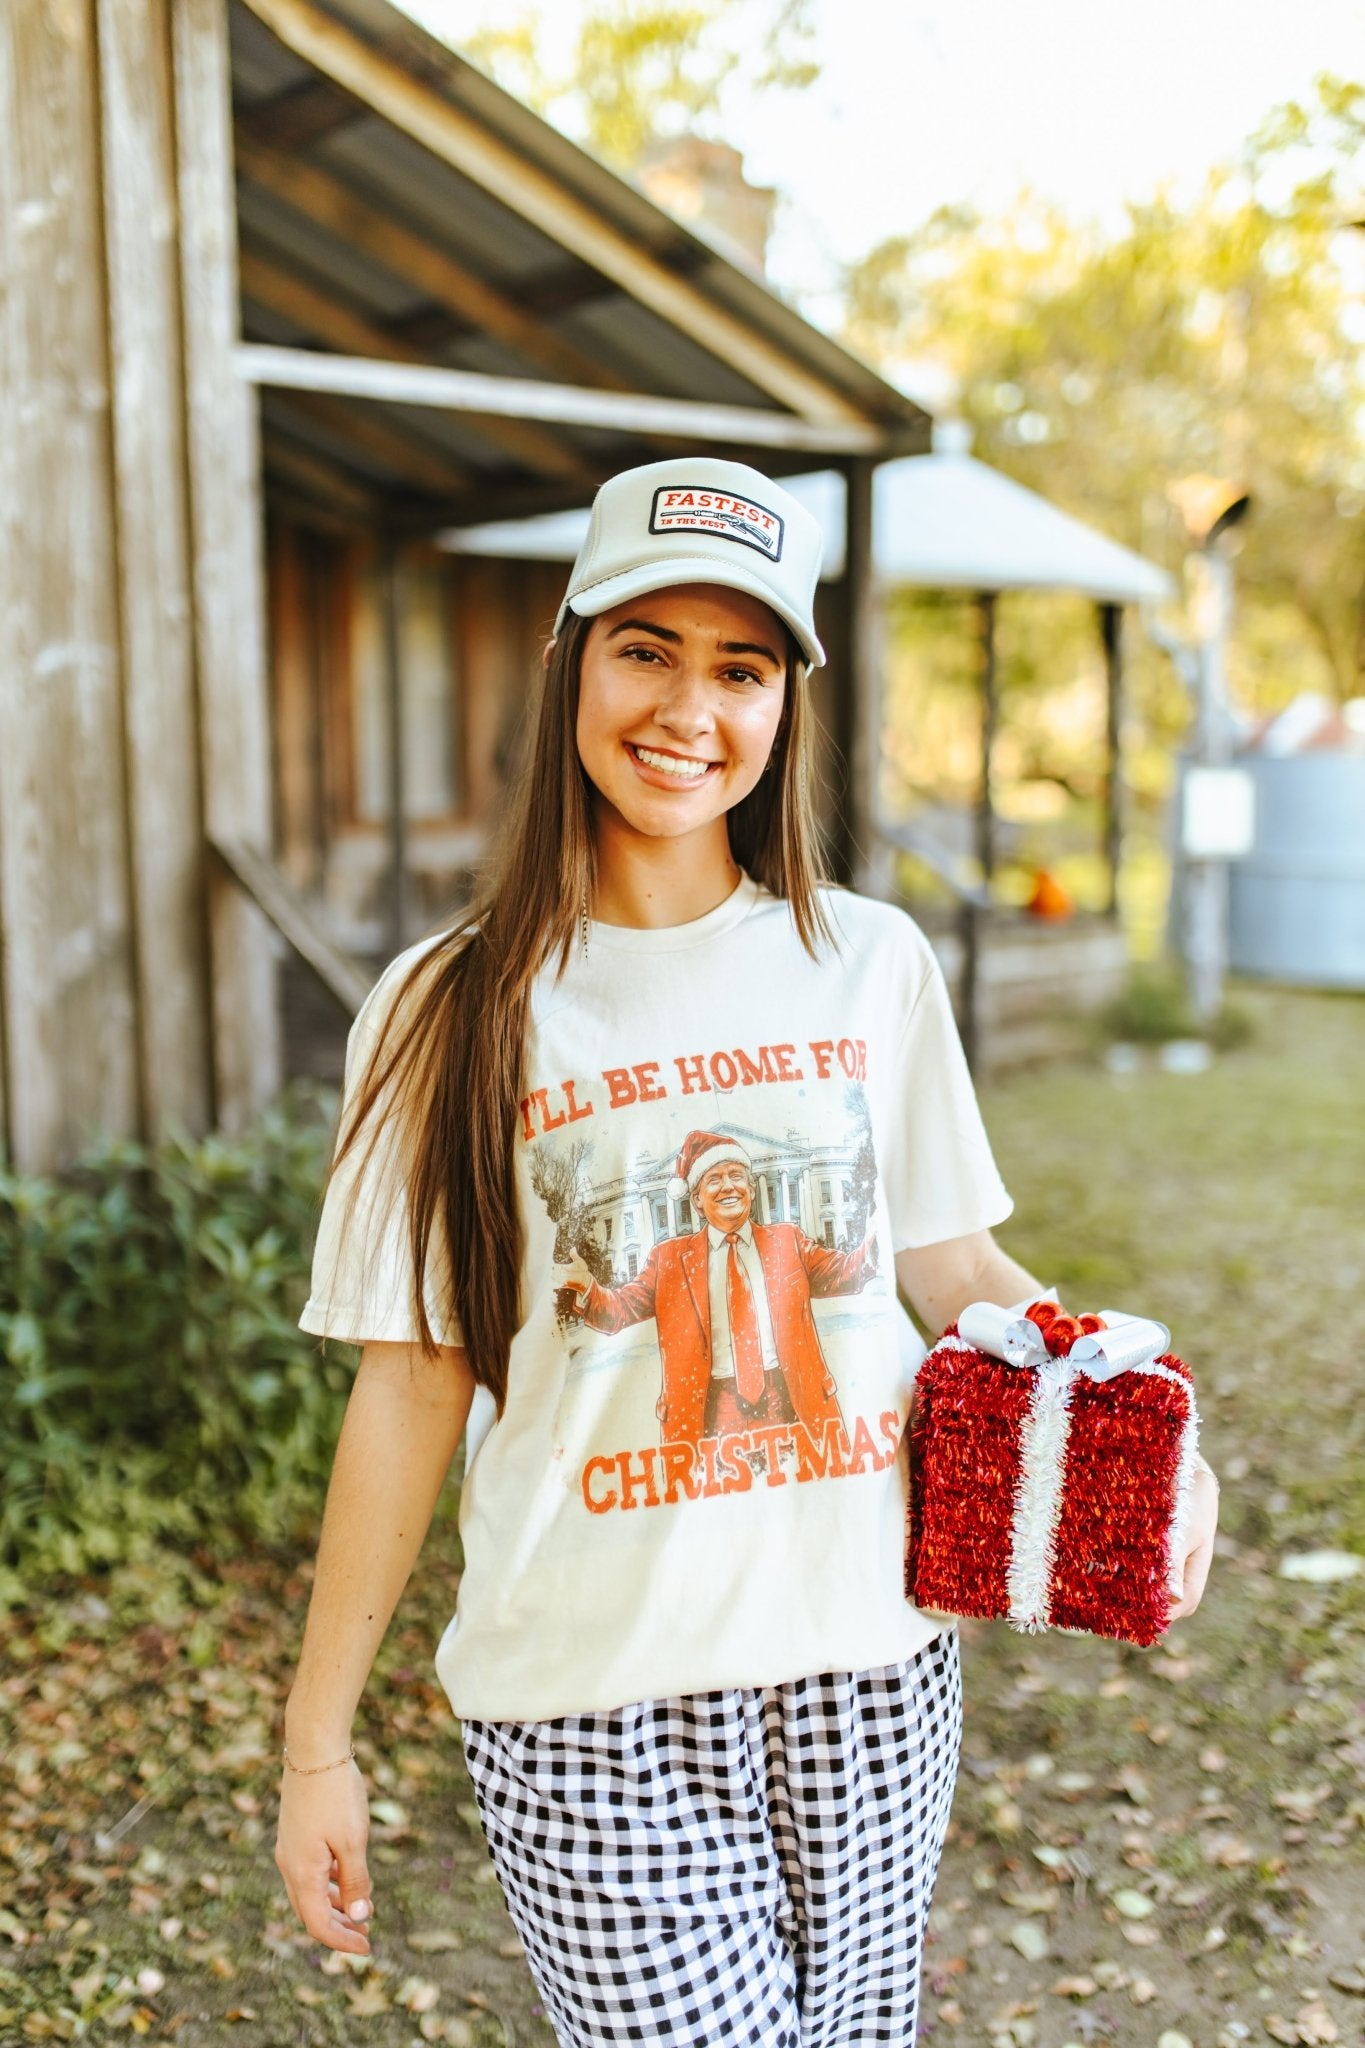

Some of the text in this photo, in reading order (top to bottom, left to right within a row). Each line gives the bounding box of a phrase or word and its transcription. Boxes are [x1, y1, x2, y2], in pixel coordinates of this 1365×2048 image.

[664, 493, 775, 530] FASTEST
[700, 519, 727, 529] WEST
[519, 1039, 867, 1141] I'LL BE HOME FOR
[582, 1409, 900, 1514] CHRISTMAS
